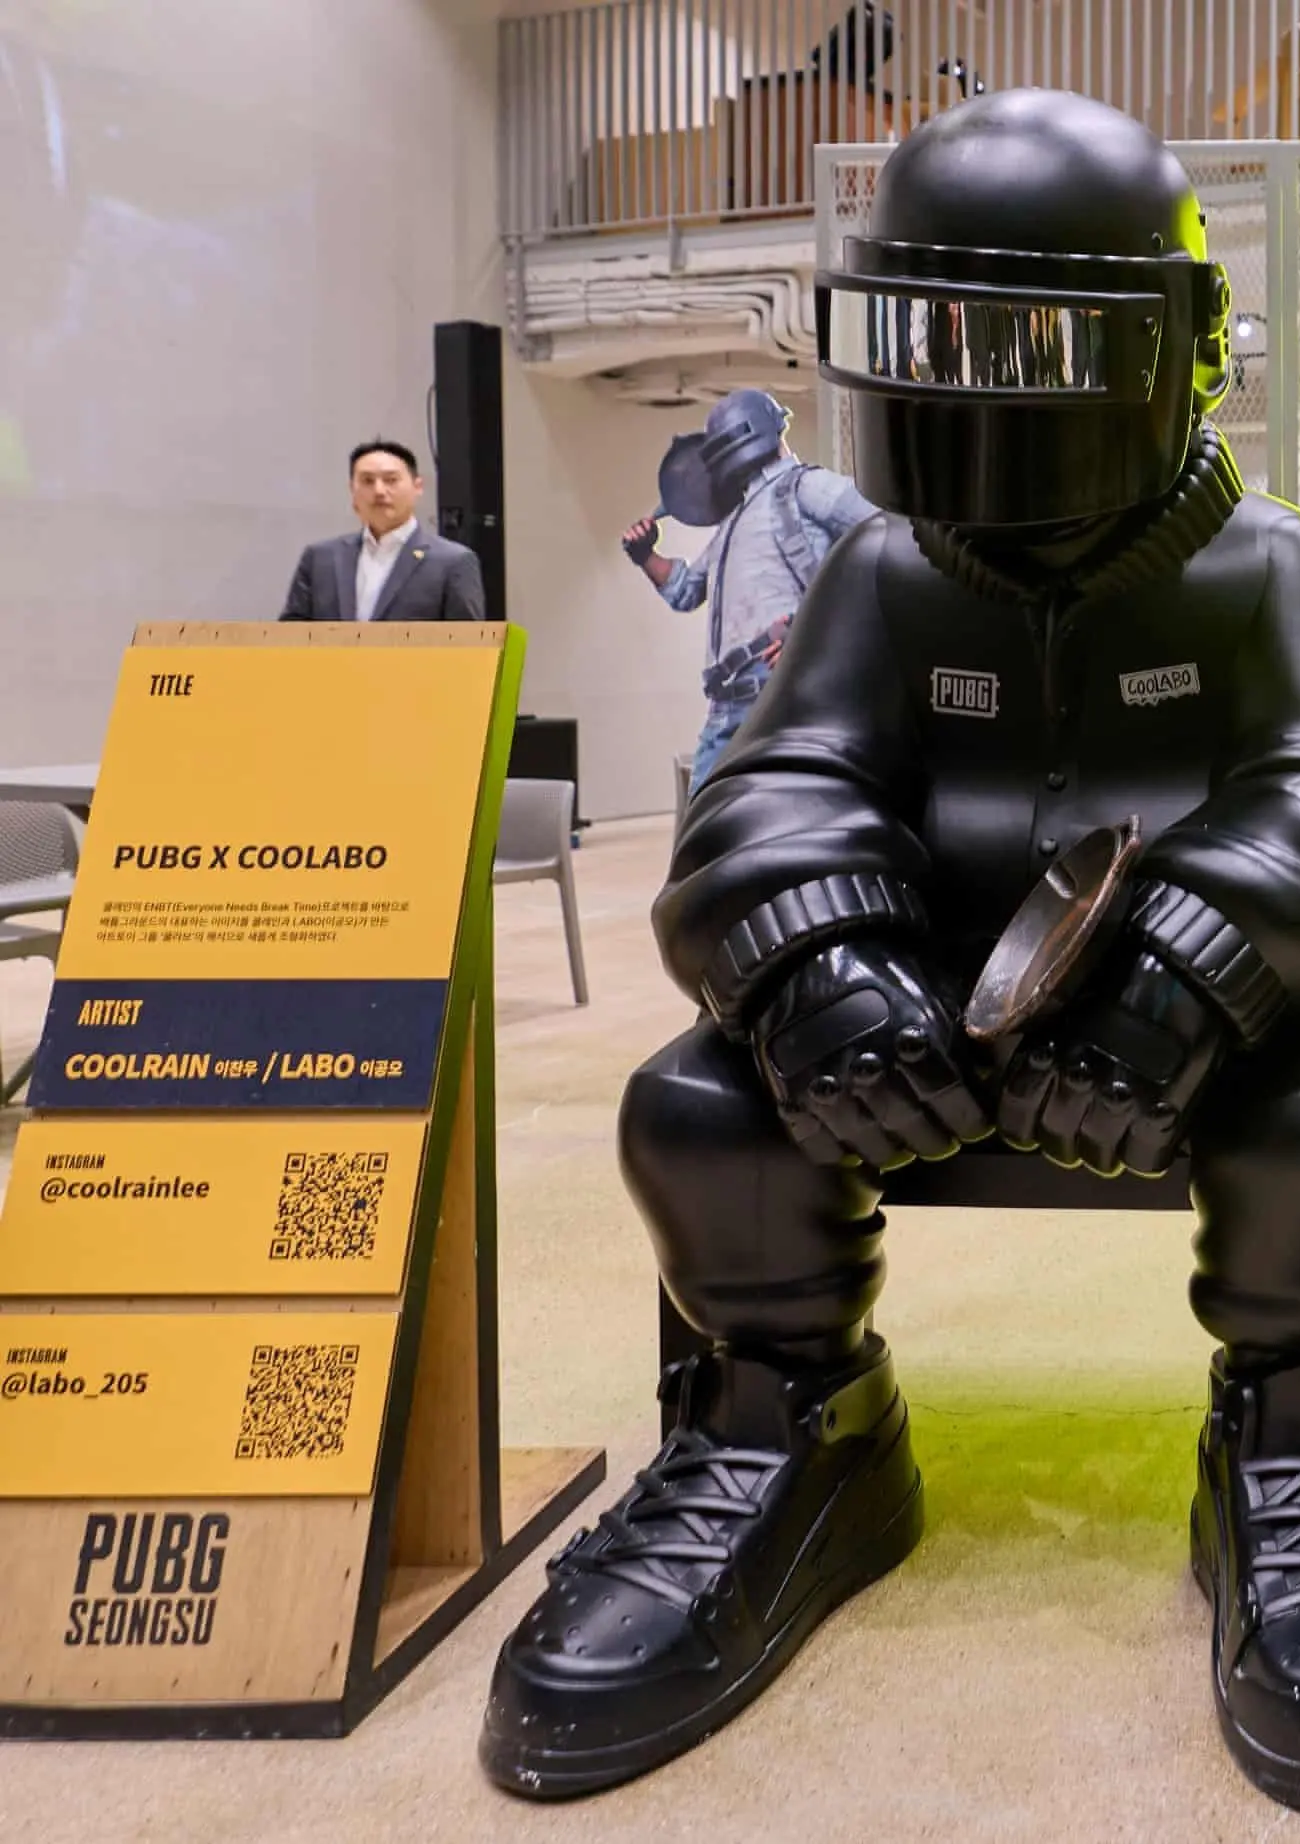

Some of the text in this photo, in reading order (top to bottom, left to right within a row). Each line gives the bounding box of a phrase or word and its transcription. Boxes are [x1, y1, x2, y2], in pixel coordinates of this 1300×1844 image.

[150, 674, 194, 696] TITLE
[940, 676, 990, 710] PUBG
[113, 845, 388, 869] PUBG X COOLABO
[78, 1000, 143, 1026] ARTIST
[65, 1054, 211, 1080] COOLRAIN
[280, 1054, 355, 1079] LABO
[46, 1155, 106, 1169] INSTAGRAM
[40, 1176, 210, 1203] @coolrainlee
[7, 1348, 68, 1364] INSTAGRAM
[1, 1371, 149, 1399] @labo_205
[73, 1513, 230, 1594] PUBG
[64, 1599, 217, 1646] SEONGSU
